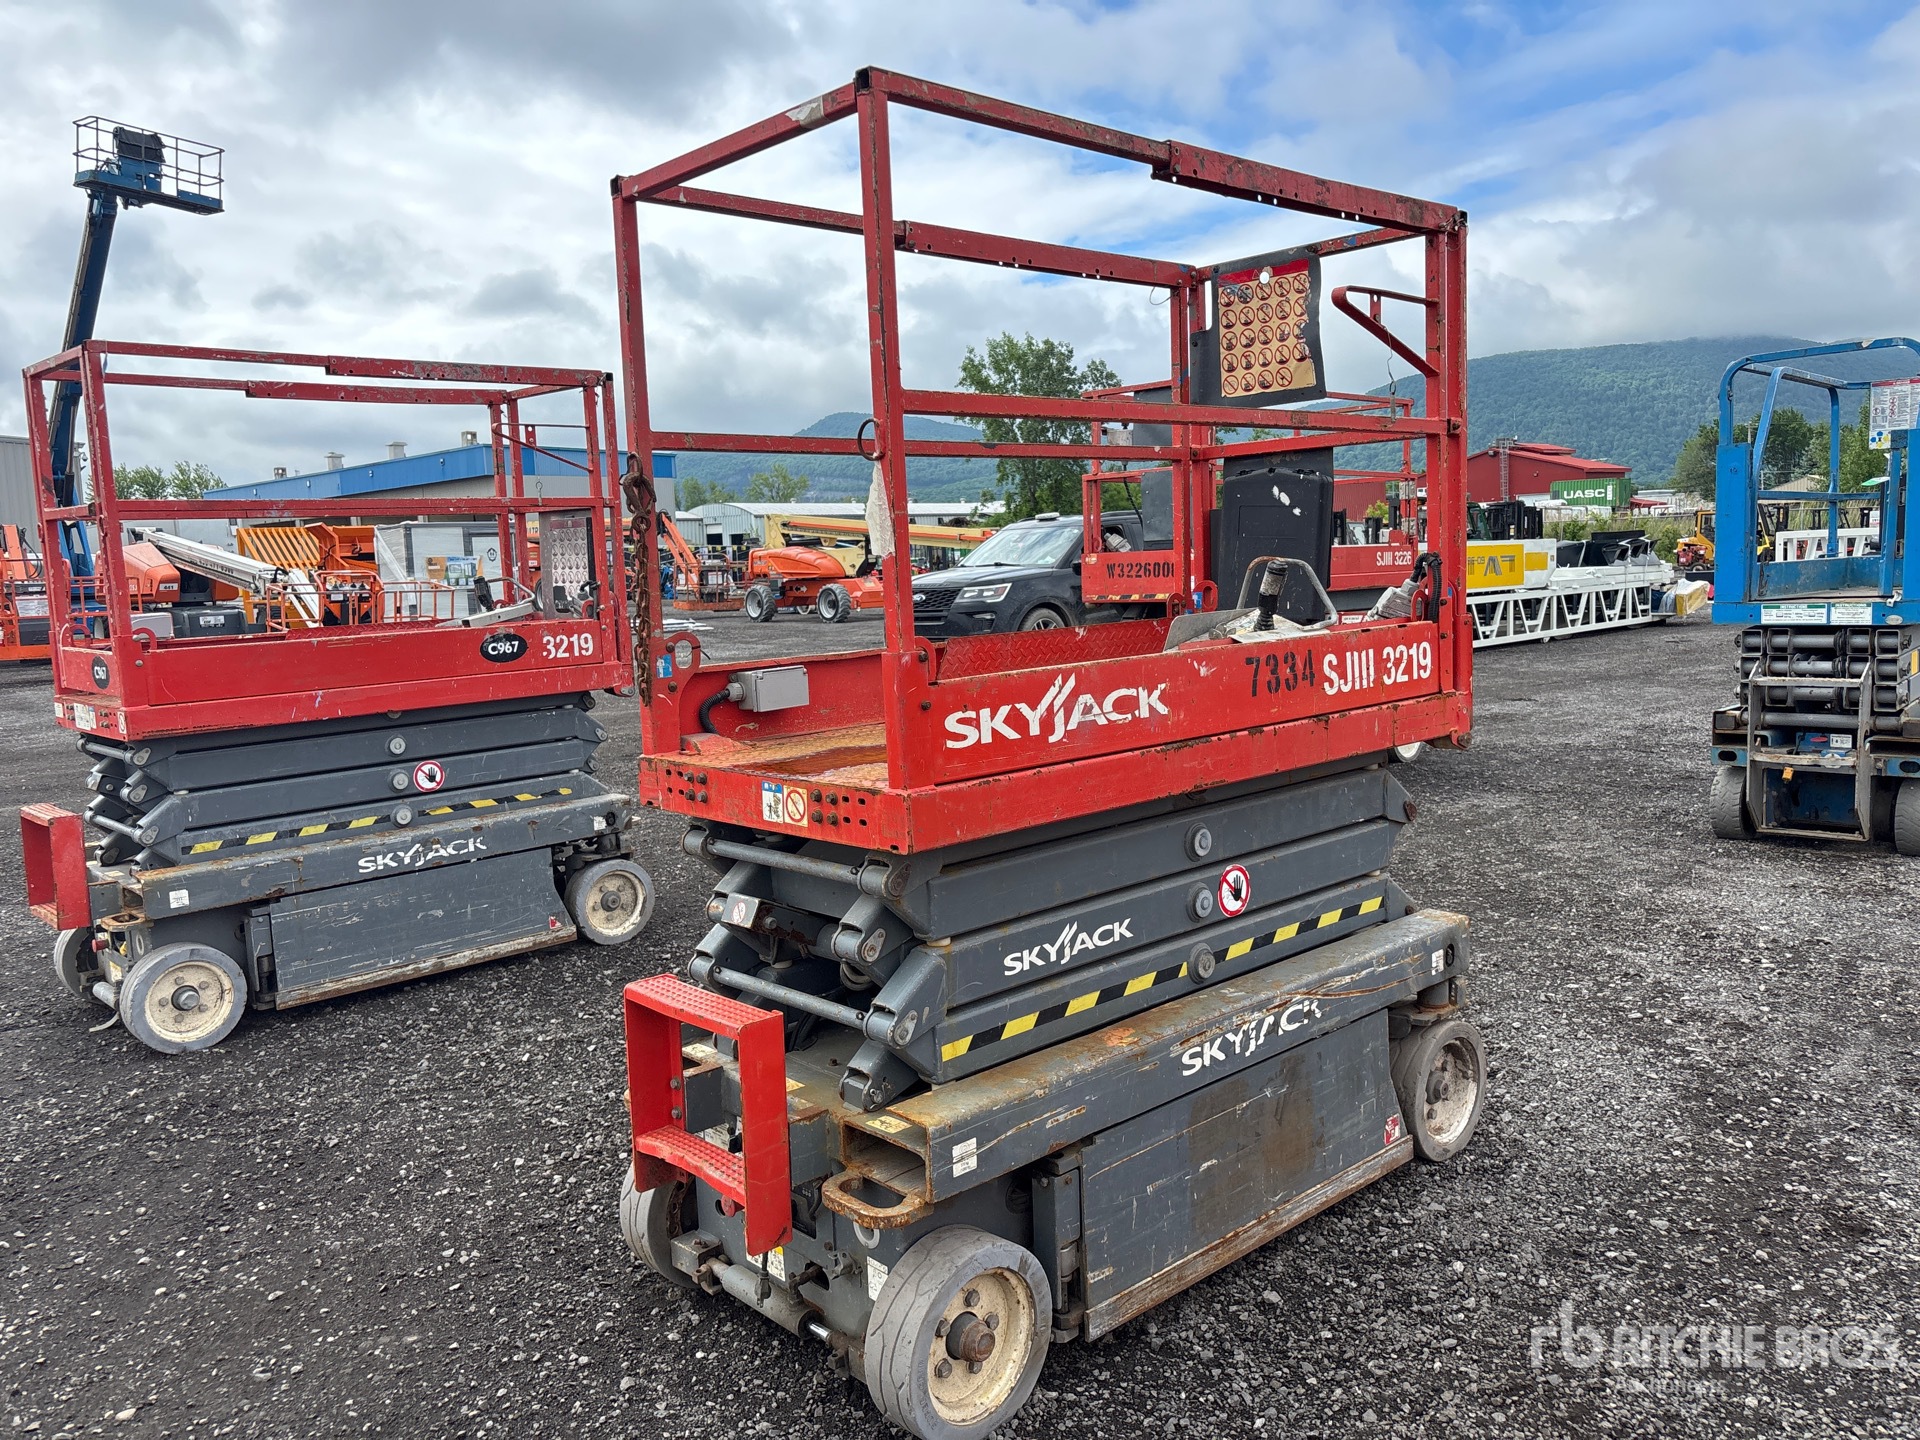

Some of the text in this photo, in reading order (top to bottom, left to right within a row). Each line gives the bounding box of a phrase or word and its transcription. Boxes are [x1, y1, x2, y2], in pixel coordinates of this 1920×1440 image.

[1563, 488, 1606, 499] UASC
[1394, 551, 1412, 565] 3226
[488, 641, 519, 655] C967
[542, 633, 594, 659] 3219
[93, 666, 107, 681] C967
[1244, 649, 1316, 697] 7334
[1322, 641, 1432, 696] SJIII 3219
[943, 672, 1169, 749] SKYJACK
[357, 837, 488, 873] SKYJACK
[1003, 918, 1134, 977] SKYJACK
[1180, 999, 1323, 1077] SKYJACK
